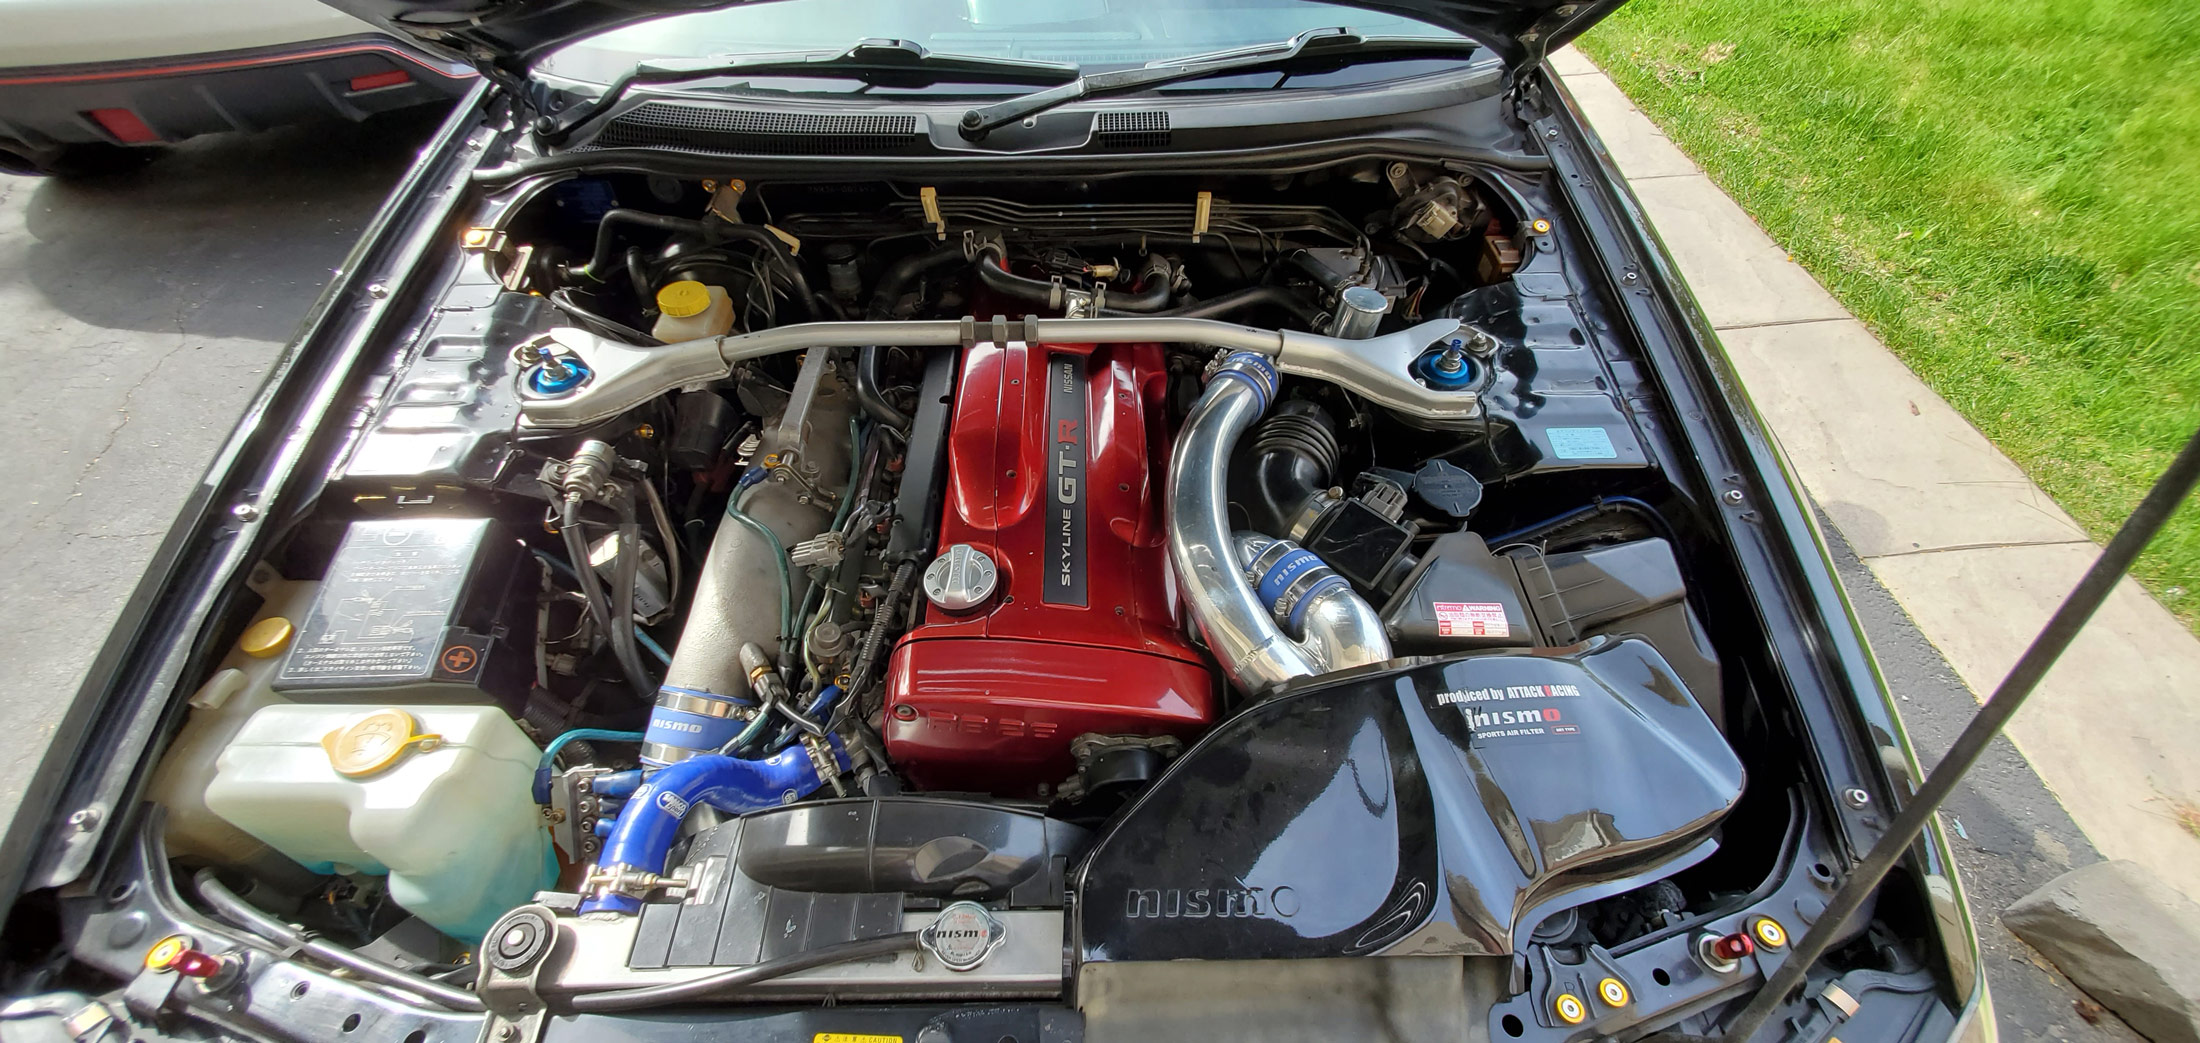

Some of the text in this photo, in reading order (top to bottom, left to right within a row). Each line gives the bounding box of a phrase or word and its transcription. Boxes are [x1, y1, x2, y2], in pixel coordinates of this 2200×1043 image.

[1063, 363, 1073, 393] NISSAN
[1061, 508, 1071, 587] SKYLINE
[1273, 555, 1318, 586] nismo
[1491, 687, 1504, 701] by
[1506, 685, 1545, 699] ATTACK
[652, 719, 703, 733] nismo
[1477, 730, 1505, 739] SPORTS
[1520, 728, 1544, 736] FILTER
